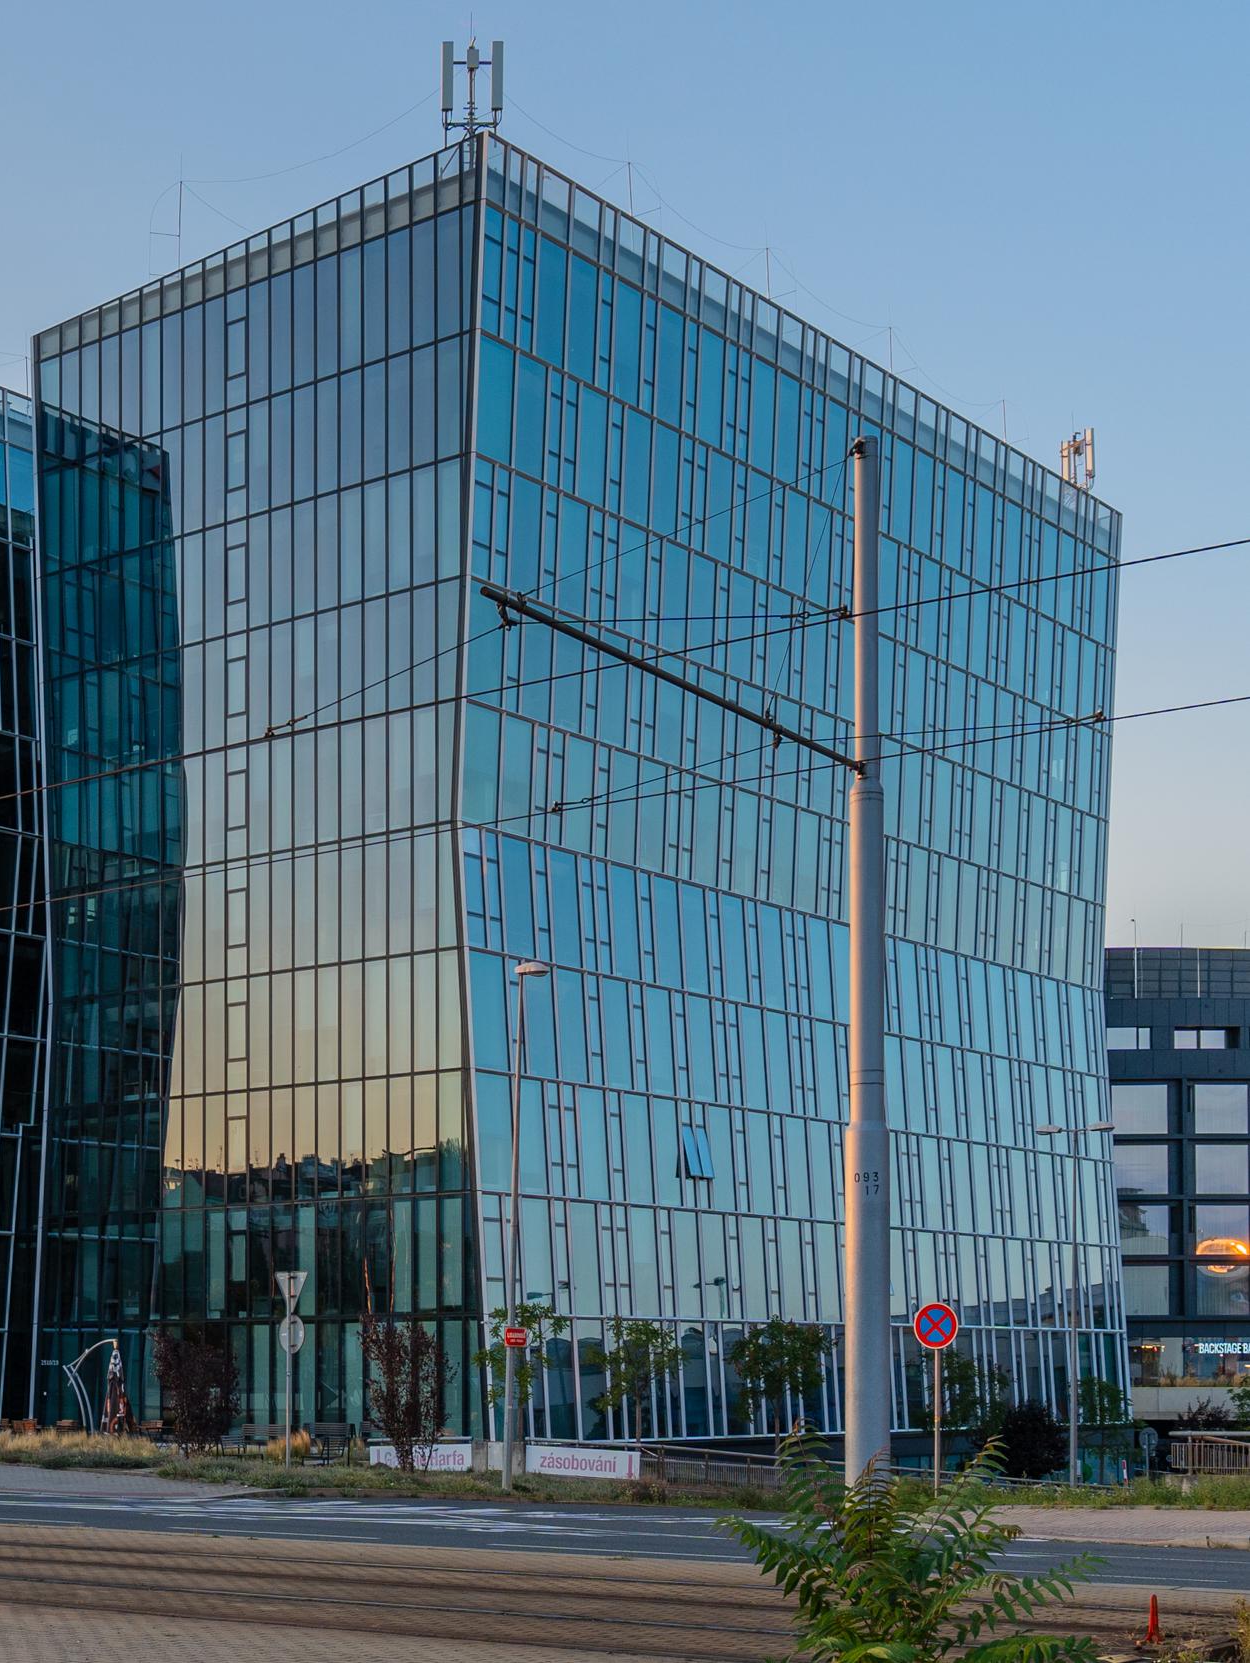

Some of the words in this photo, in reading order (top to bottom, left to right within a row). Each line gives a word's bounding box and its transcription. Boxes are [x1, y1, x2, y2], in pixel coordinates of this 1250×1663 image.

[854, 1172, 879, 1183] 093
[865, 1185, 879, 1196] 17
[1198, 1342, 1242, 1354] BACKSTAGE
[540, 1452, 617, 1473] zásobování
